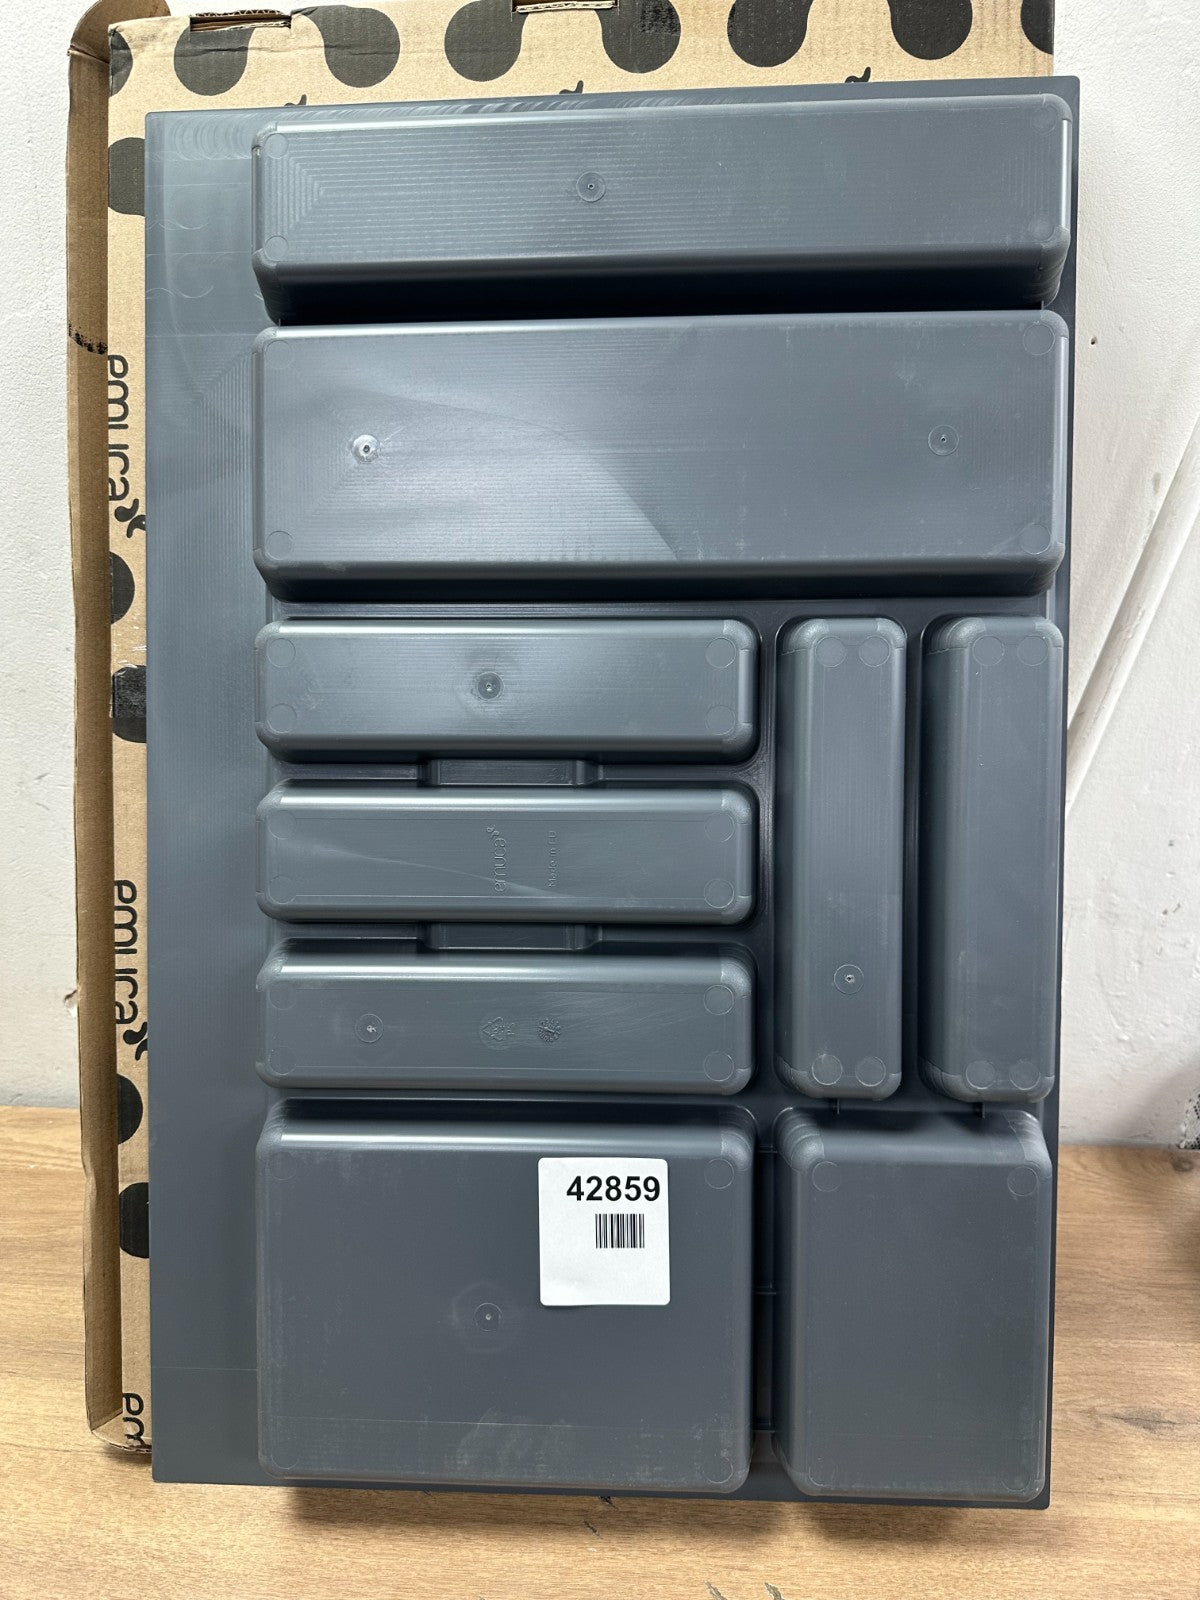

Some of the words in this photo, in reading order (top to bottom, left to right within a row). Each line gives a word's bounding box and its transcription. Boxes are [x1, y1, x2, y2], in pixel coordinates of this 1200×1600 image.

[493, 837, 507, 892] emuca
[548, 860, 558, 887] Made
[566, 1175, 661, 1202] 42859
